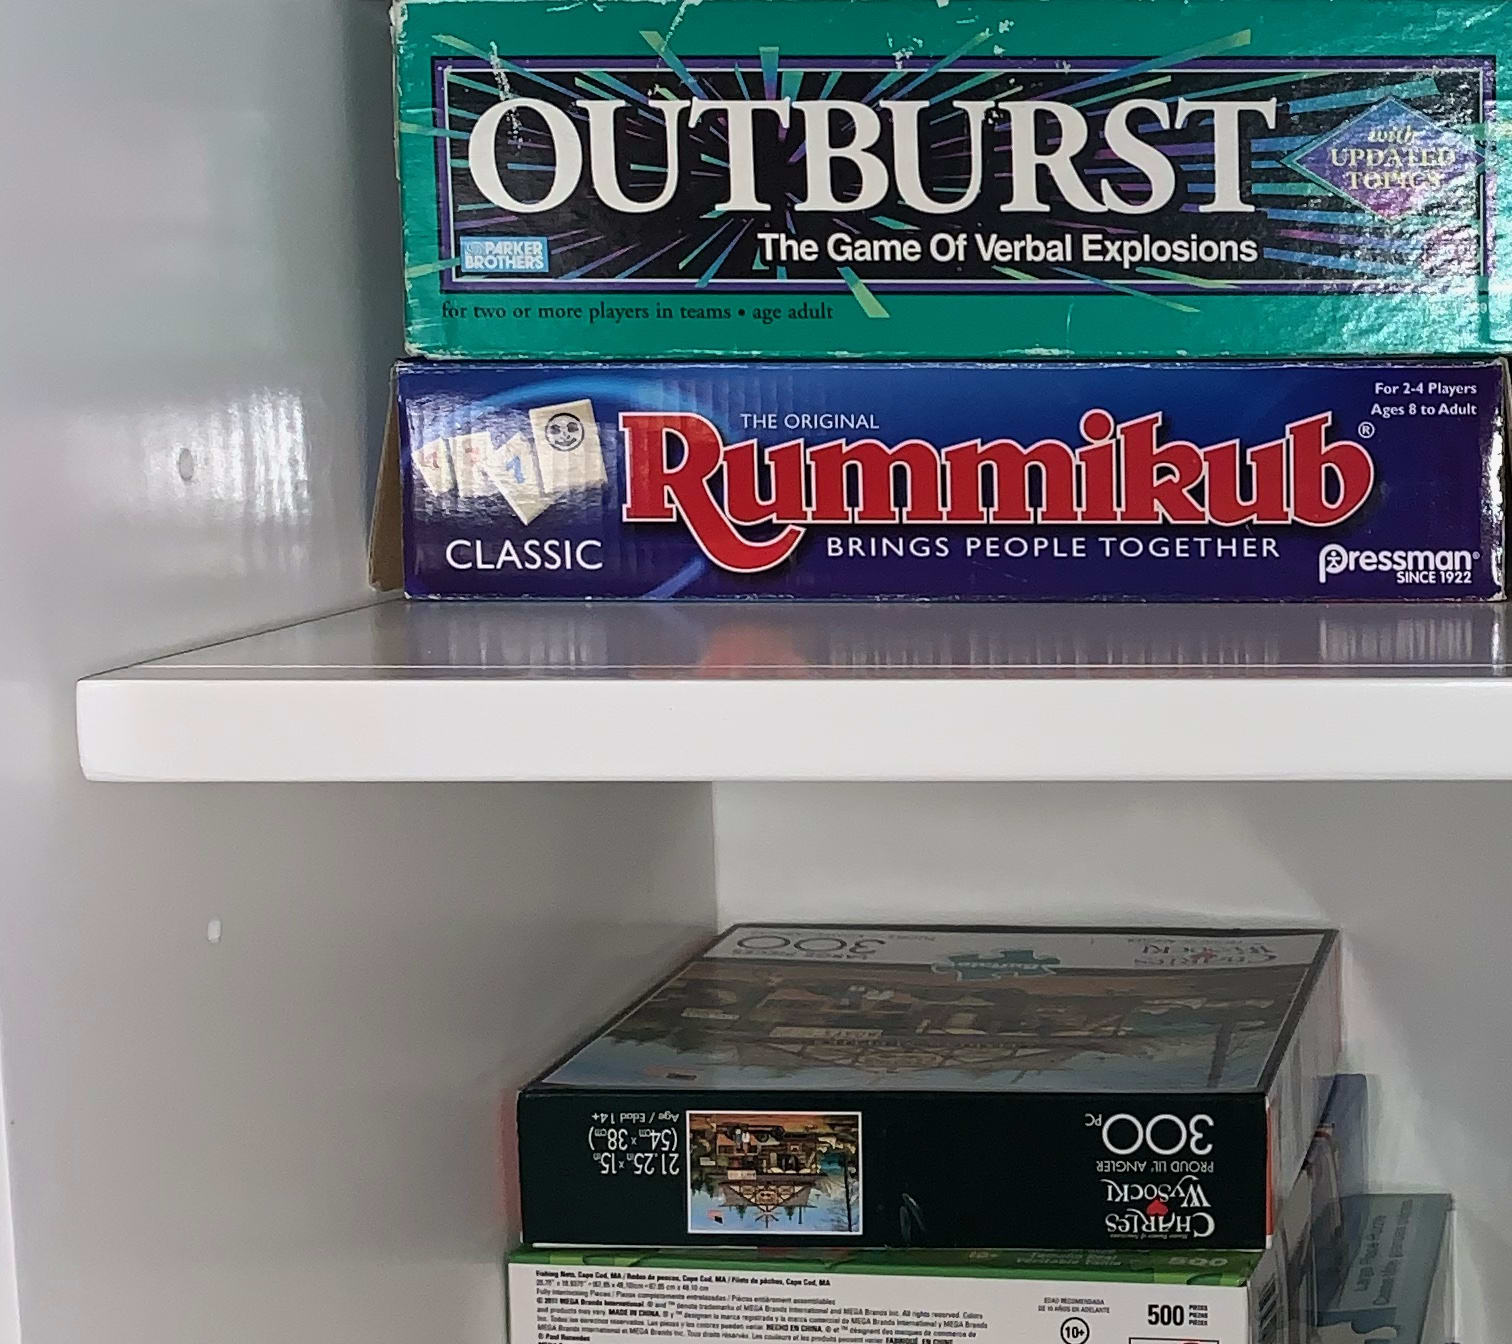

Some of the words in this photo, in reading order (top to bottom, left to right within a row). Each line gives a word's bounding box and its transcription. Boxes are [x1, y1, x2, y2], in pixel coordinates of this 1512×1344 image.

[1367, 124, 1420, 146] with
[467, 96, 1280, 215] OUTBURST
[1328, 146, 1457, 171] UPDATED
[1345, 169, 1445, 193] TOPICS
[484, 240, 545, 257] PARKER
[757, 232, 820, 262] The
[826, 232, 922, 262] Game
[928, 233, 970, 262] Of
[974, 232, 1080, 262] Verbal
[1081, 232, 1260, 270] Explosions
[464, 256, 545, 272] BROTHERS
[442, 302, 470, 321] for
[473, 305, 508, 321] two
[512, 307, 534, 321] or
[537, 307, 583, 321] more
[587, 301, 651, 332] players
[655, 302, 675, 321] in
[679, 305, 732, 321] teams
[752, 307, 783, 327] age
[786, 301, 834, 321] adult
[1374, 382, 1400, 396] For
[1402, 382, 1425, 396] 2-4
[1428, 381, 1479, 398] Players
[740, 413, 777, 430] THE
[783, 412, 880, 431] ORIGINAL
[1370, 403, 1405, 419] Ages
[1408, 403, 1417, 417] 8
[1420, 403, 1435, 417] to
[1437, 402, 1479, 417] Adult
[618, 408, 1375, 573] Rummikub
[445, 538, 604, 572] CLASSIC
[827, 536, 951, 559] BRINGS
[966, 537, 1087, 559] PEOPLE
[1098, 536, 1281, 559] TOGETHER
[1396, 570, 1437, 585] SINCE
[1438, 570, 1473, 585] 1922
[1084, 1112, 1103, 1127] PC
[1101, 1112, 1215, 1156] 300
[1095, 1160, 1148, 1174] ANGLER
[1170, 1160, 1215, 1174] PROUD
[1146, 1303, 1186, 1327] 500
[1063, 1325, 1086, 1340] 10+
